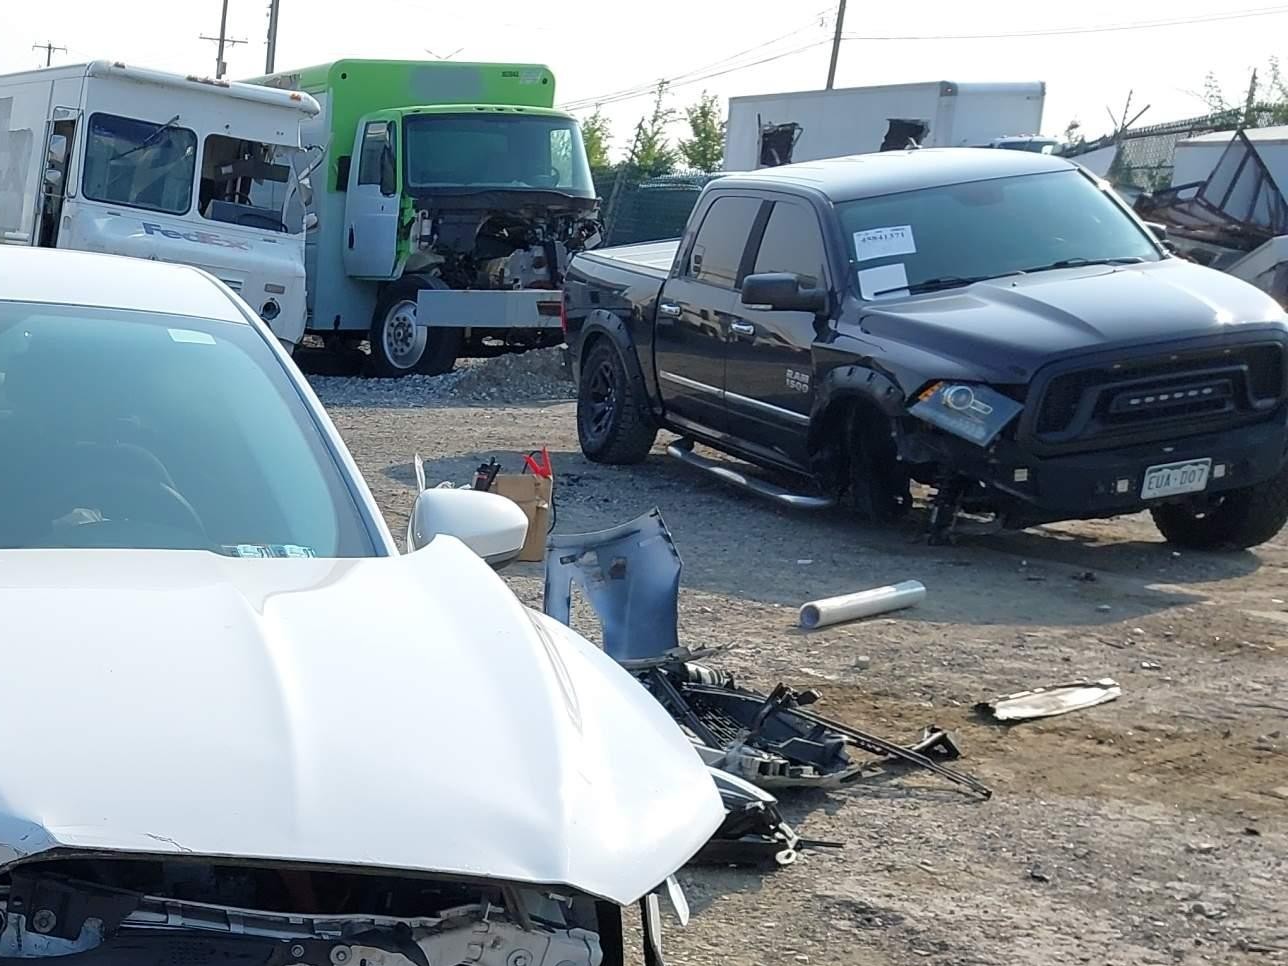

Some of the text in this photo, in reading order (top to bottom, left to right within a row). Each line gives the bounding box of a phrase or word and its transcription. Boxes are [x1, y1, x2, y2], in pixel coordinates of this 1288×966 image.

[142, 222, 249, 250] FedEx
[786, 369, 809, 384] RAM
[786, 378, 809, 393] 1500
